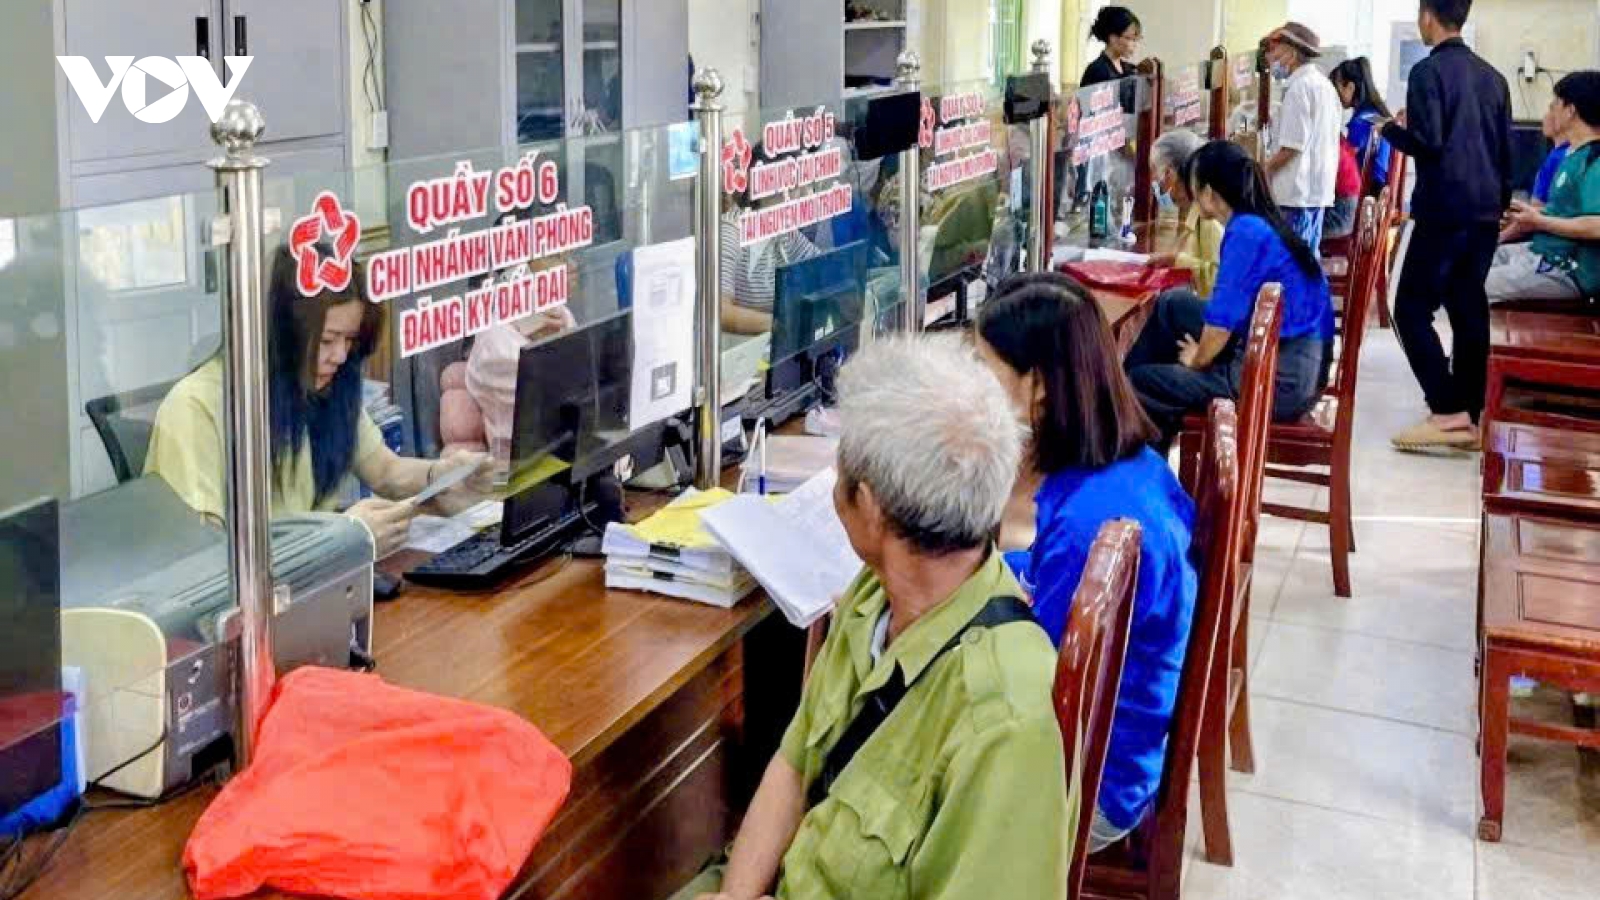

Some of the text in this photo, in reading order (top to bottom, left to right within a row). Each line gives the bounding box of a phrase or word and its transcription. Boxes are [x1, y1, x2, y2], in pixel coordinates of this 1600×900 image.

[825, 113, 834, 142] 5
[409, 153, 557, 229] QUẦY SỐ 6
[370, 205, 592, 297] CHI NHÁNH VĂN PHÒNG
[402, 267, 567, 353] ĐĂNG KÝ ĐẤT ĐAI
